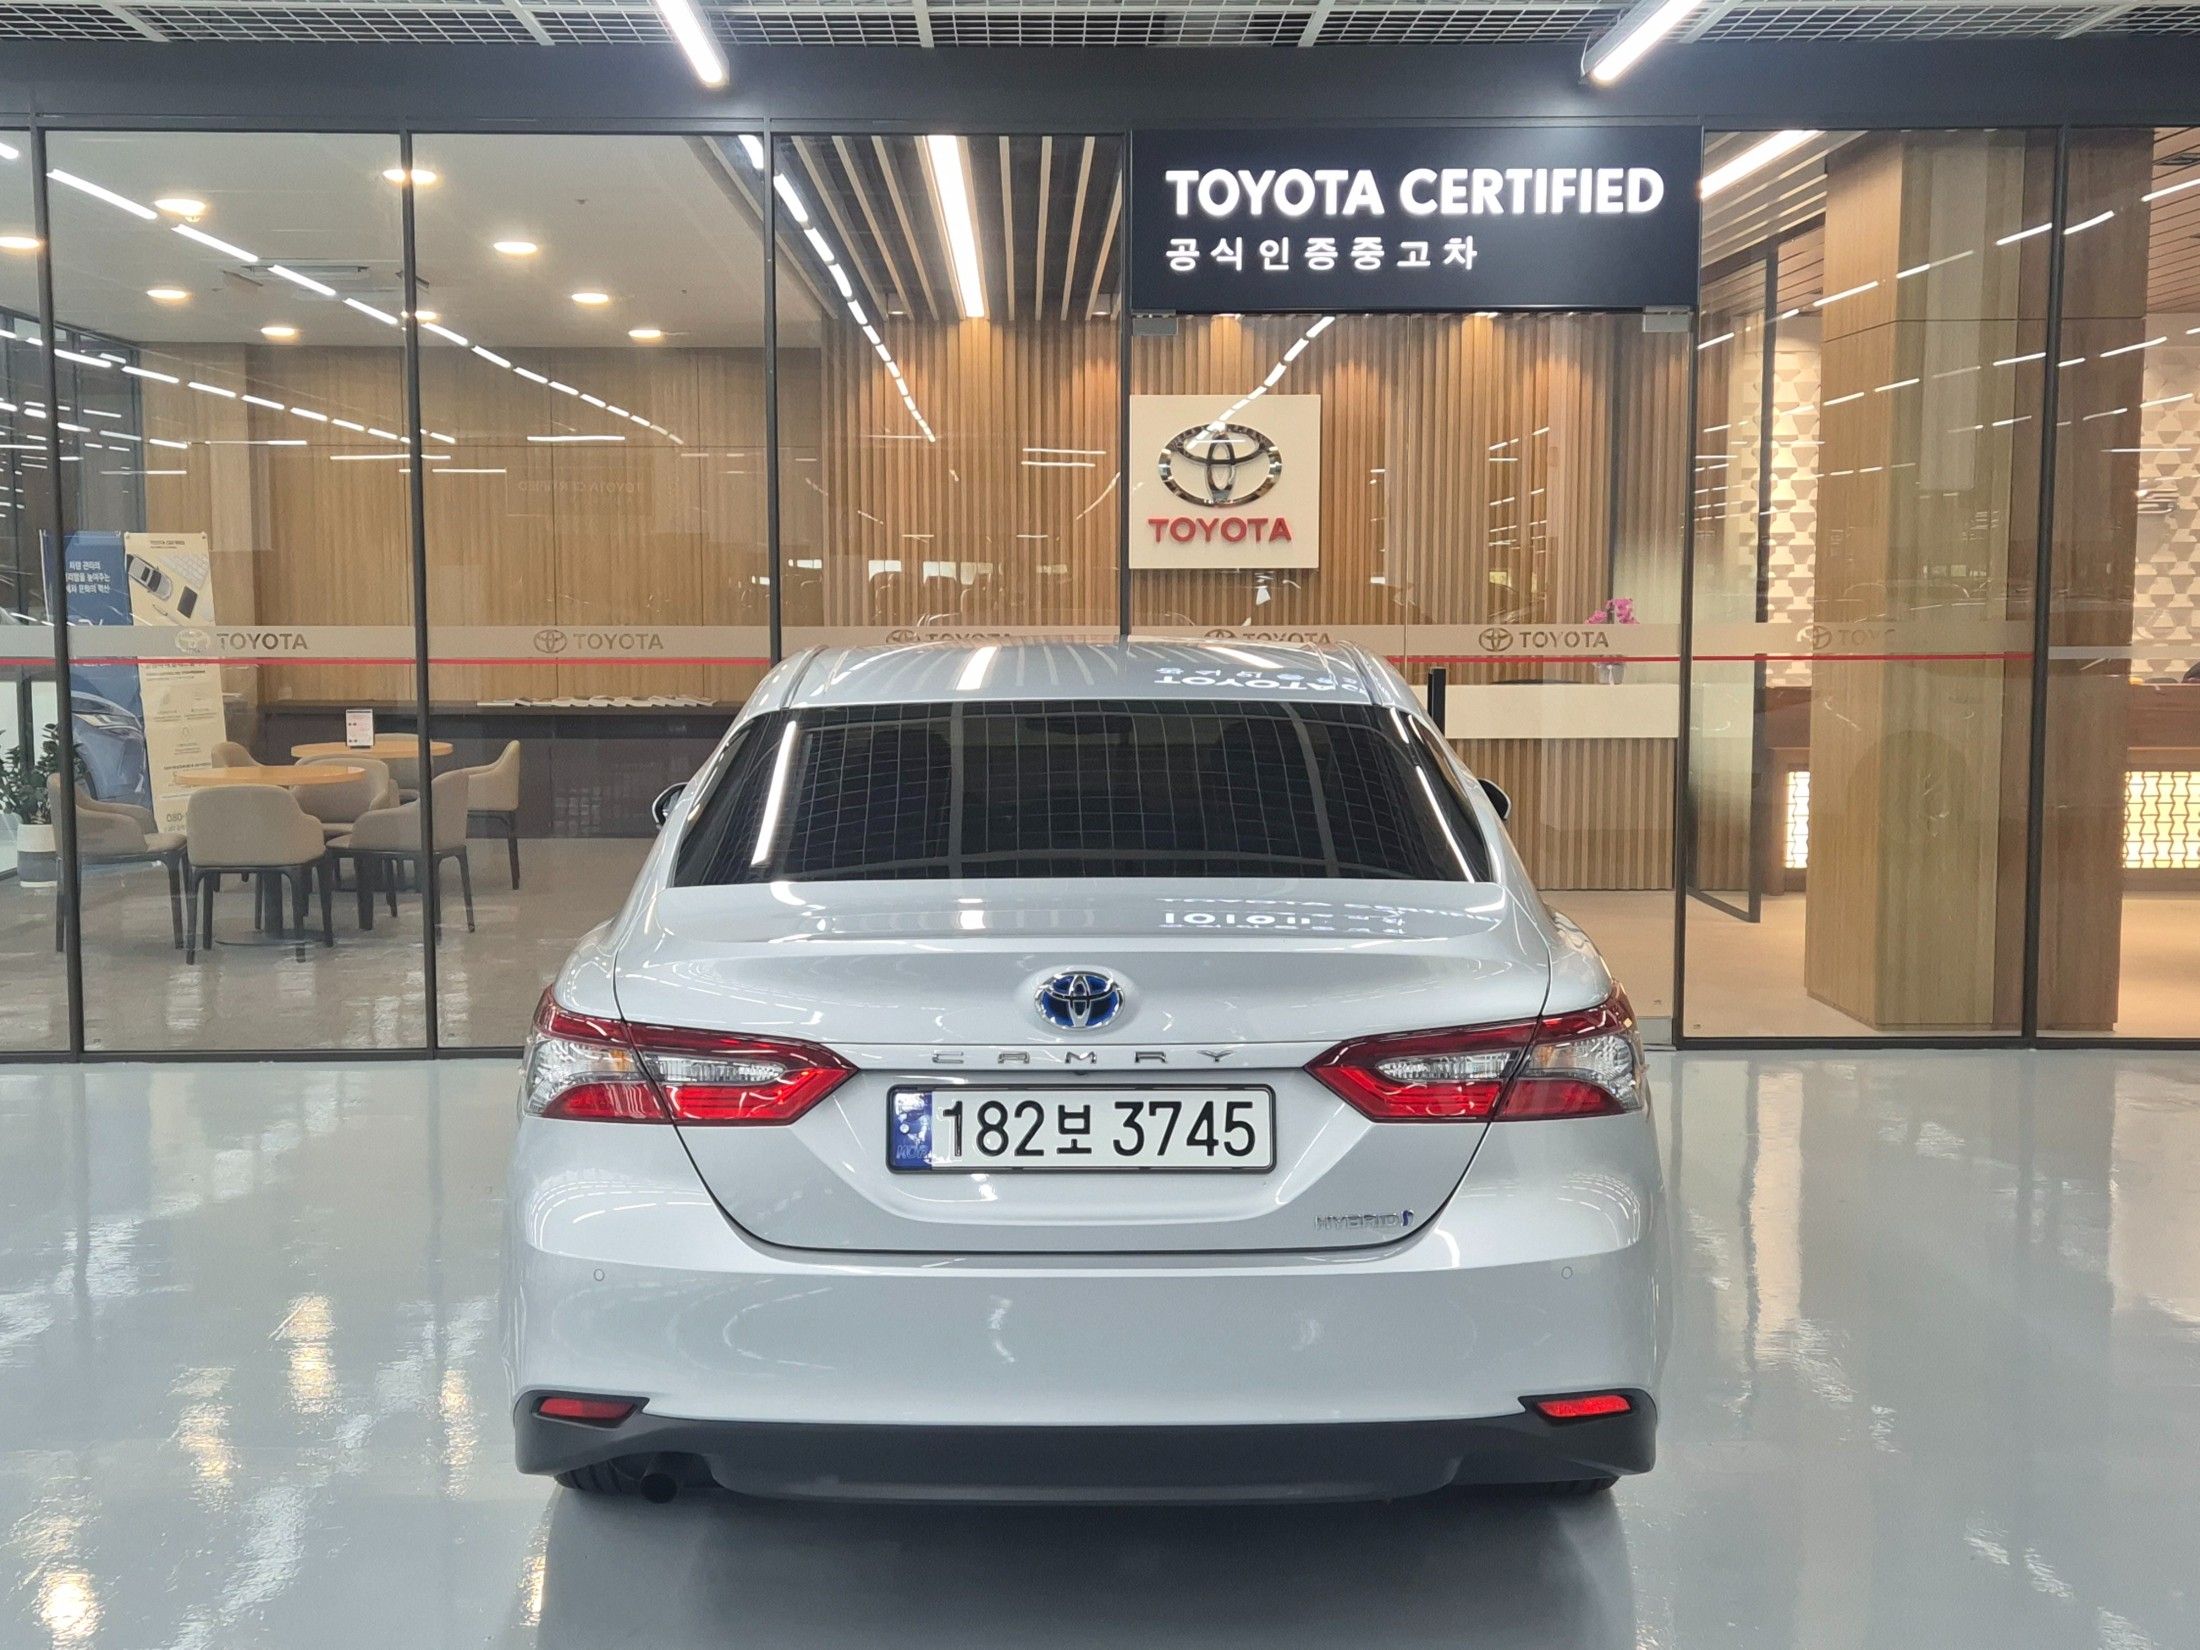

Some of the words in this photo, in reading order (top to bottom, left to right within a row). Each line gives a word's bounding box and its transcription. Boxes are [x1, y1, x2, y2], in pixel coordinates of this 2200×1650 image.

[1165, 167, 1385, 216] TOYOTA
[1400, 167, 1665, 215] CERTIFIED
[1165, 235, 1479, 272] 공식인증중고차
[1148, 517, 1292, 543] TOYOTA
[216, 632, 308, 650] TOYOTA
[573, 633, 664, 650] TOYOTA
[1519, 631, 1609, 648] TOYOTA
[932, 1051, 1236, 1064] CAMRY
[943, 1100, 1092, 1157] 182보
[1113, 1100, 1255, 1157] 3745
[1314, 1213, 1400, 1230] HYBRID
